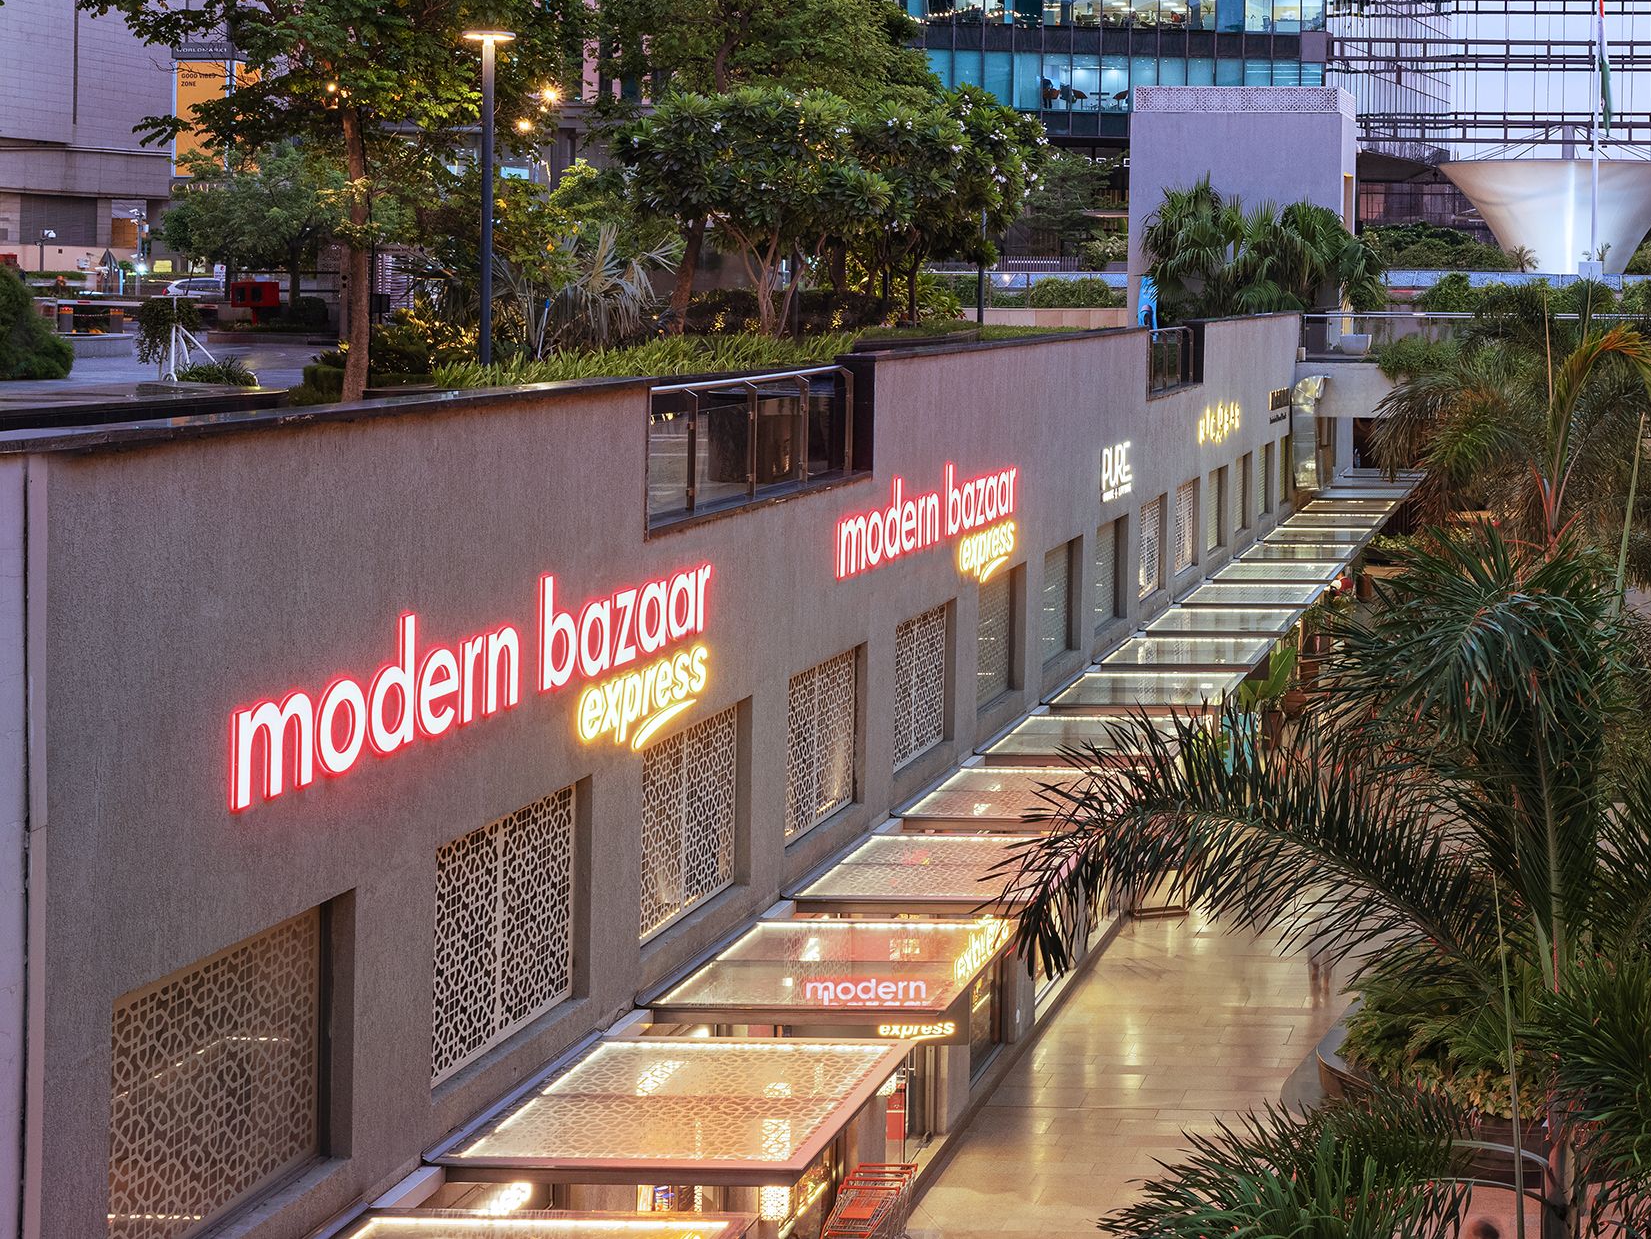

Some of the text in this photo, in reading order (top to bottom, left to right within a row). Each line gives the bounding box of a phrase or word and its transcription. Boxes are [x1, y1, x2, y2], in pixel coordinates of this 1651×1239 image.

[1101, 441, 1132, 491] PURE
[837, 464, 1016, 578] modern bazaar
[960, 522, 1015, 577] express
[232, 564, 712, 810] modern bazaar
[580, 646, 708, 743] express
[806, 978, 927, 1000] modern
[879, 1022, 955, 1038] express
